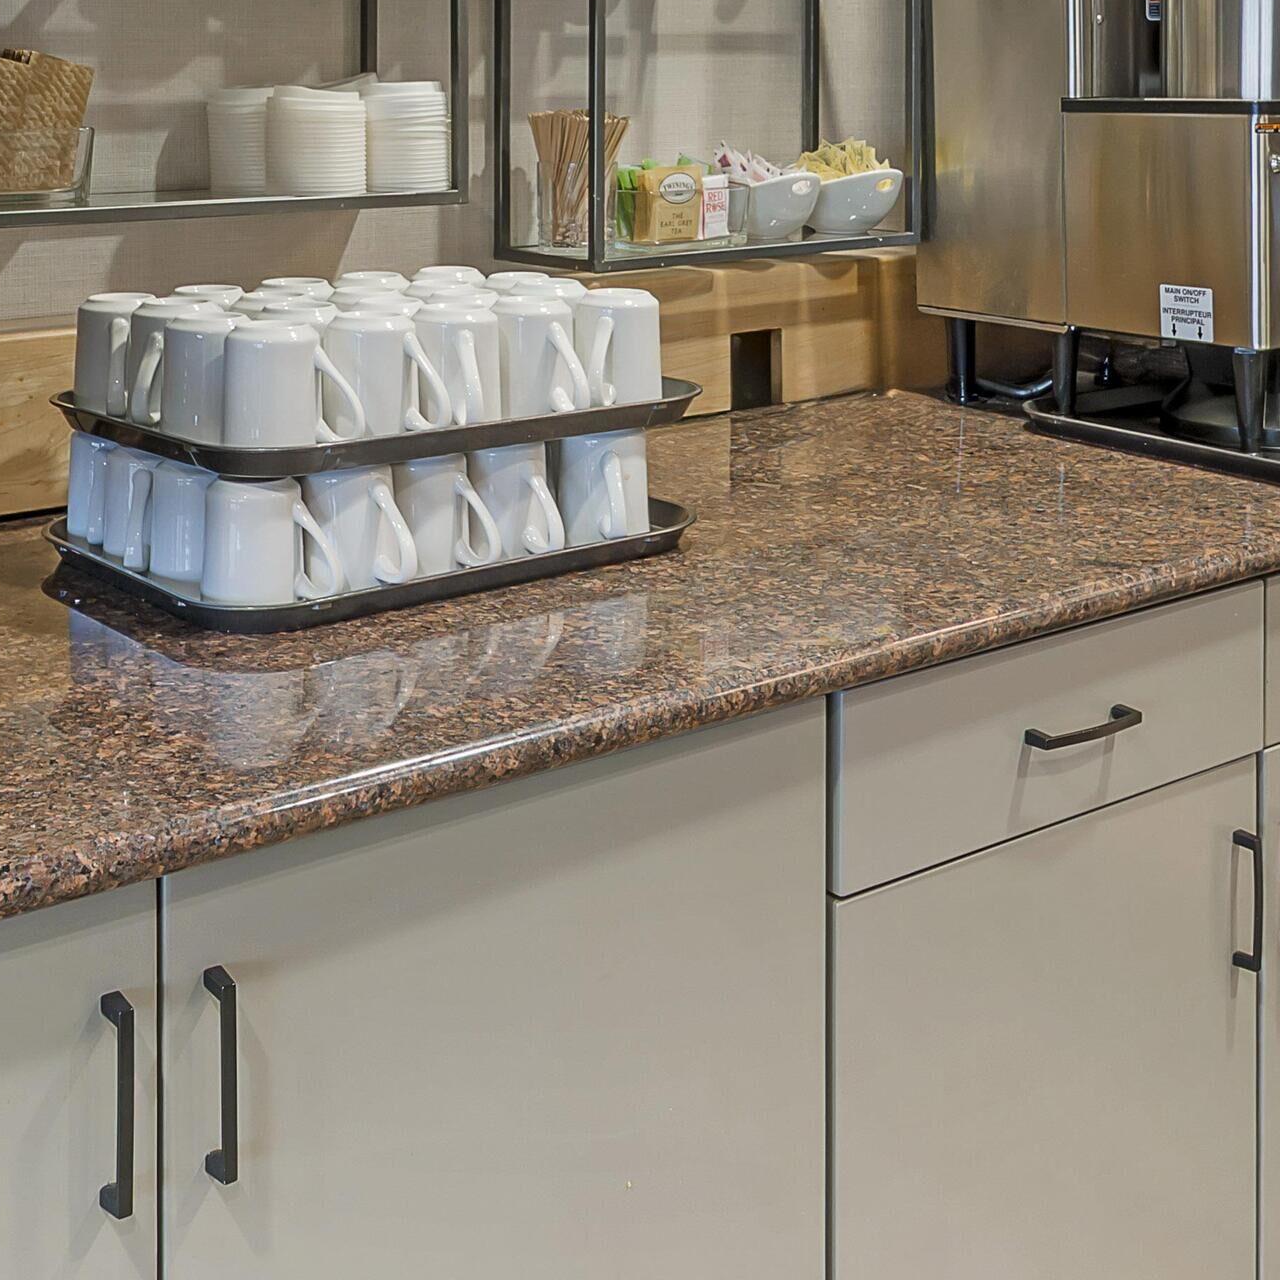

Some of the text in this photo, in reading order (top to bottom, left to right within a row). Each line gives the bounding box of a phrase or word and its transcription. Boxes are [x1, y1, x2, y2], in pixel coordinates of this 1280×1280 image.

[707, 191, 723, 202] RED
[1182, 288, 1207, 297] ON/OFF
[1174, 295, 1200, 304] SWITCH
[1162, 307, 1212, 319] INTERRUPTEUR
[1171, 315, 1206, 326] PRINCIPAL
